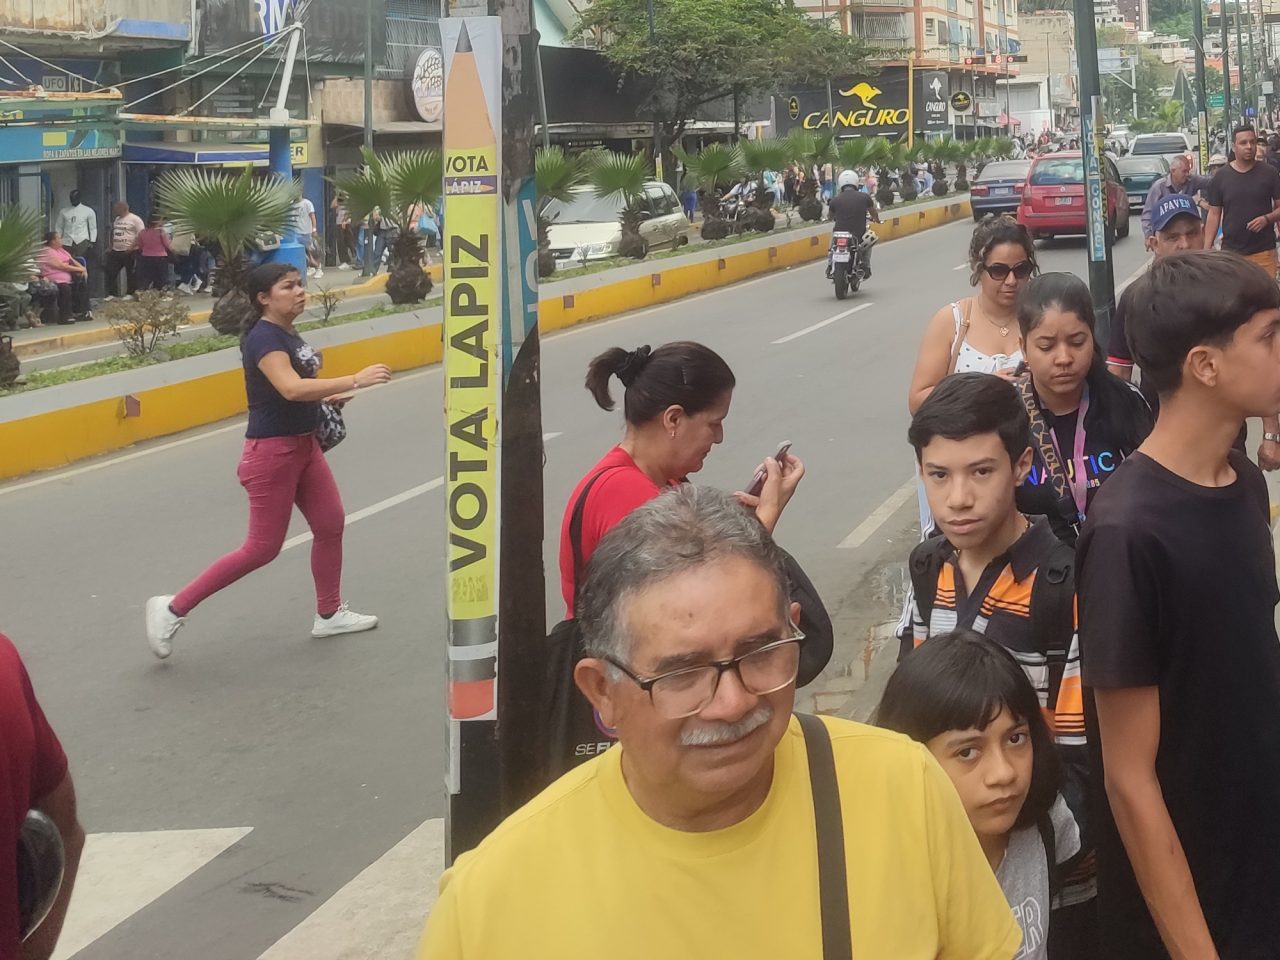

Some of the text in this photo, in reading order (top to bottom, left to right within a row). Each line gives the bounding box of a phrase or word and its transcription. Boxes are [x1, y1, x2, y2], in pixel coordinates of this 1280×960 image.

[44, 78, 65, 89] UFO
[803, 108, 909, 129] CANGURO
[450, 233, 489, 390] LAPIZ
[449, 406, 489, 574] VOTA
